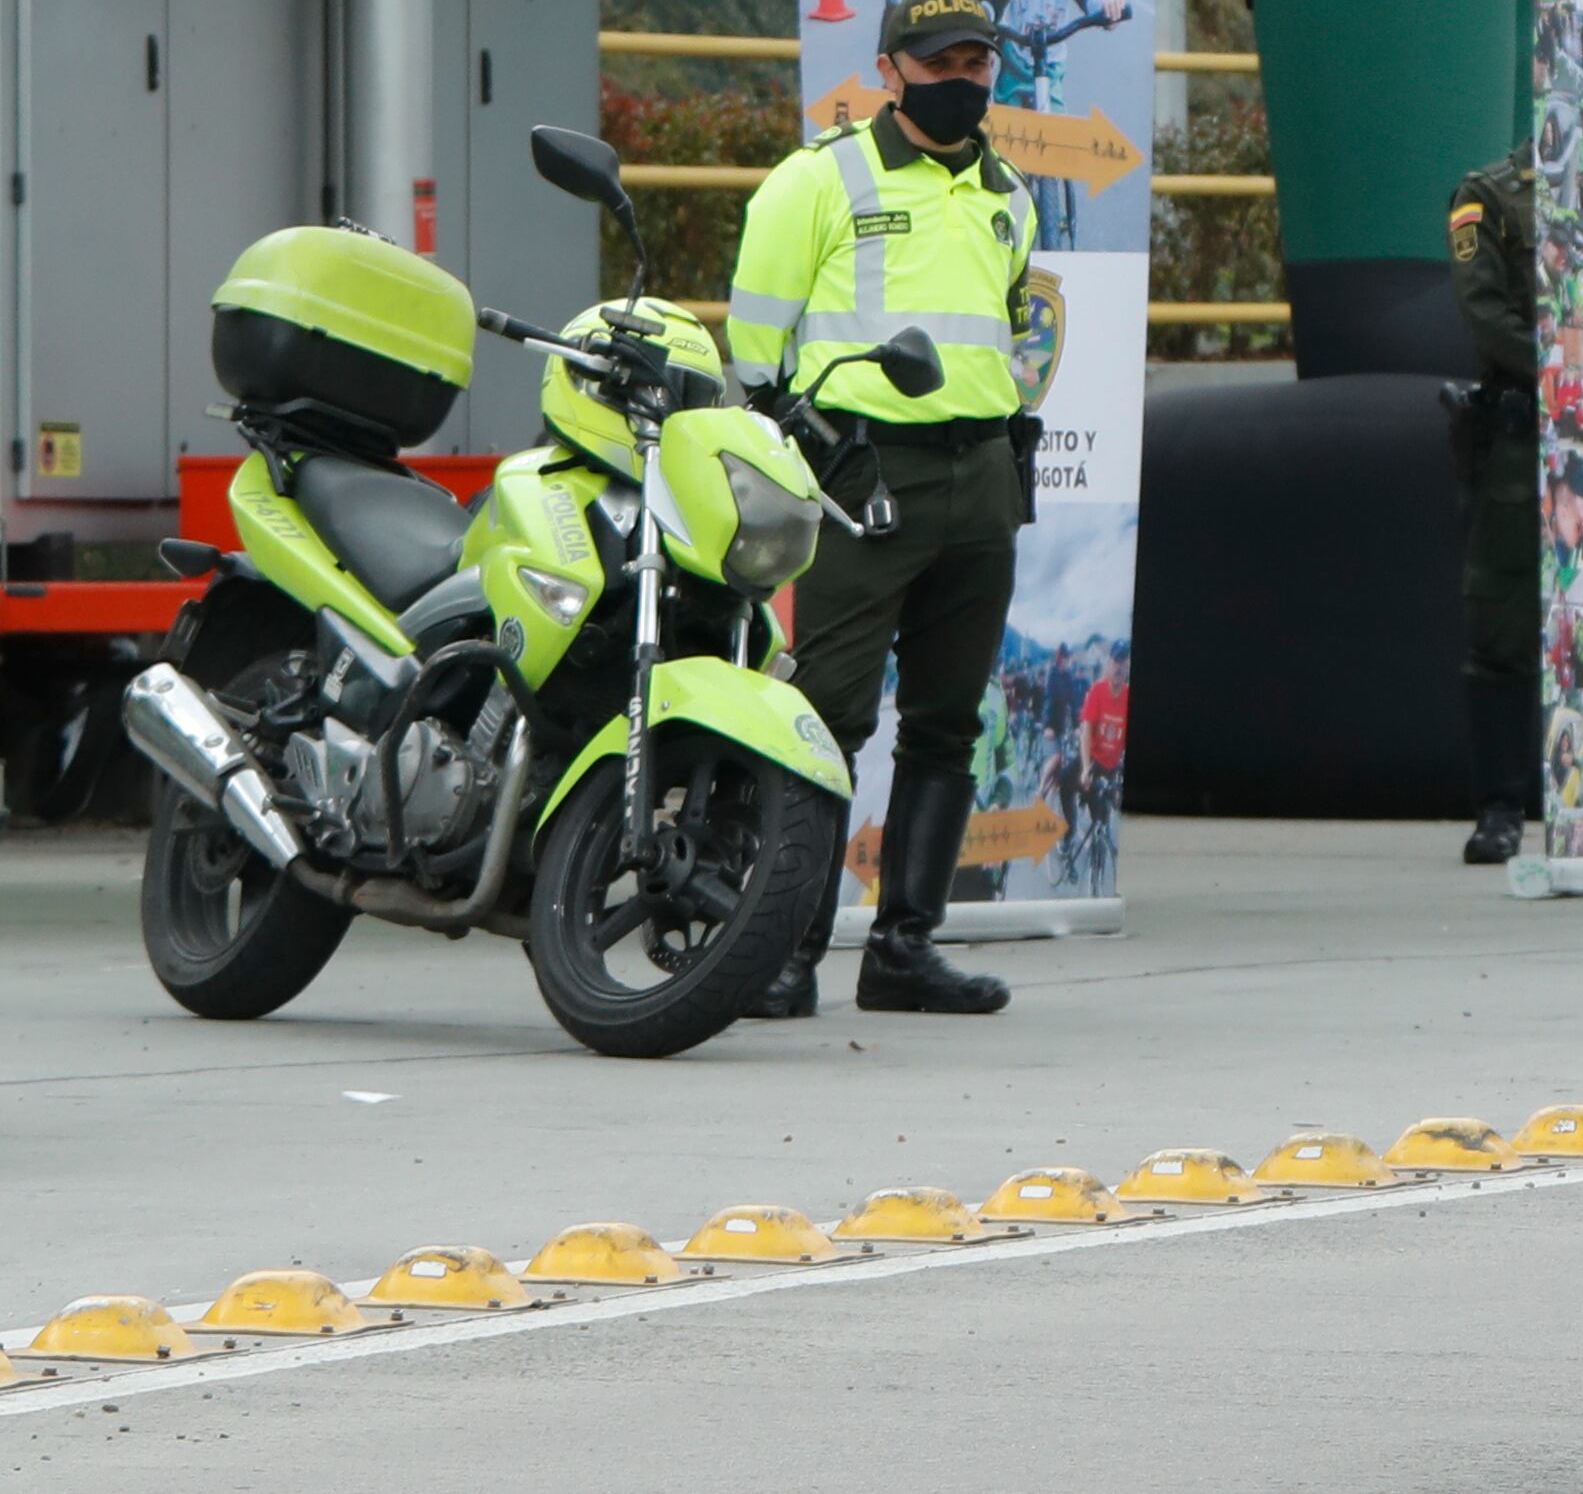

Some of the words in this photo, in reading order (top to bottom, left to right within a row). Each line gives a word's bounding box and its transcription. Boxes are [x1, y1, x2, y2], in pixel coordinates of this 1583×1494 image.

[1034, 430, 1078, 452] SITO
[1085, 430, 1097, 452] Y
[549, 492, 591, 563] POLICIA
